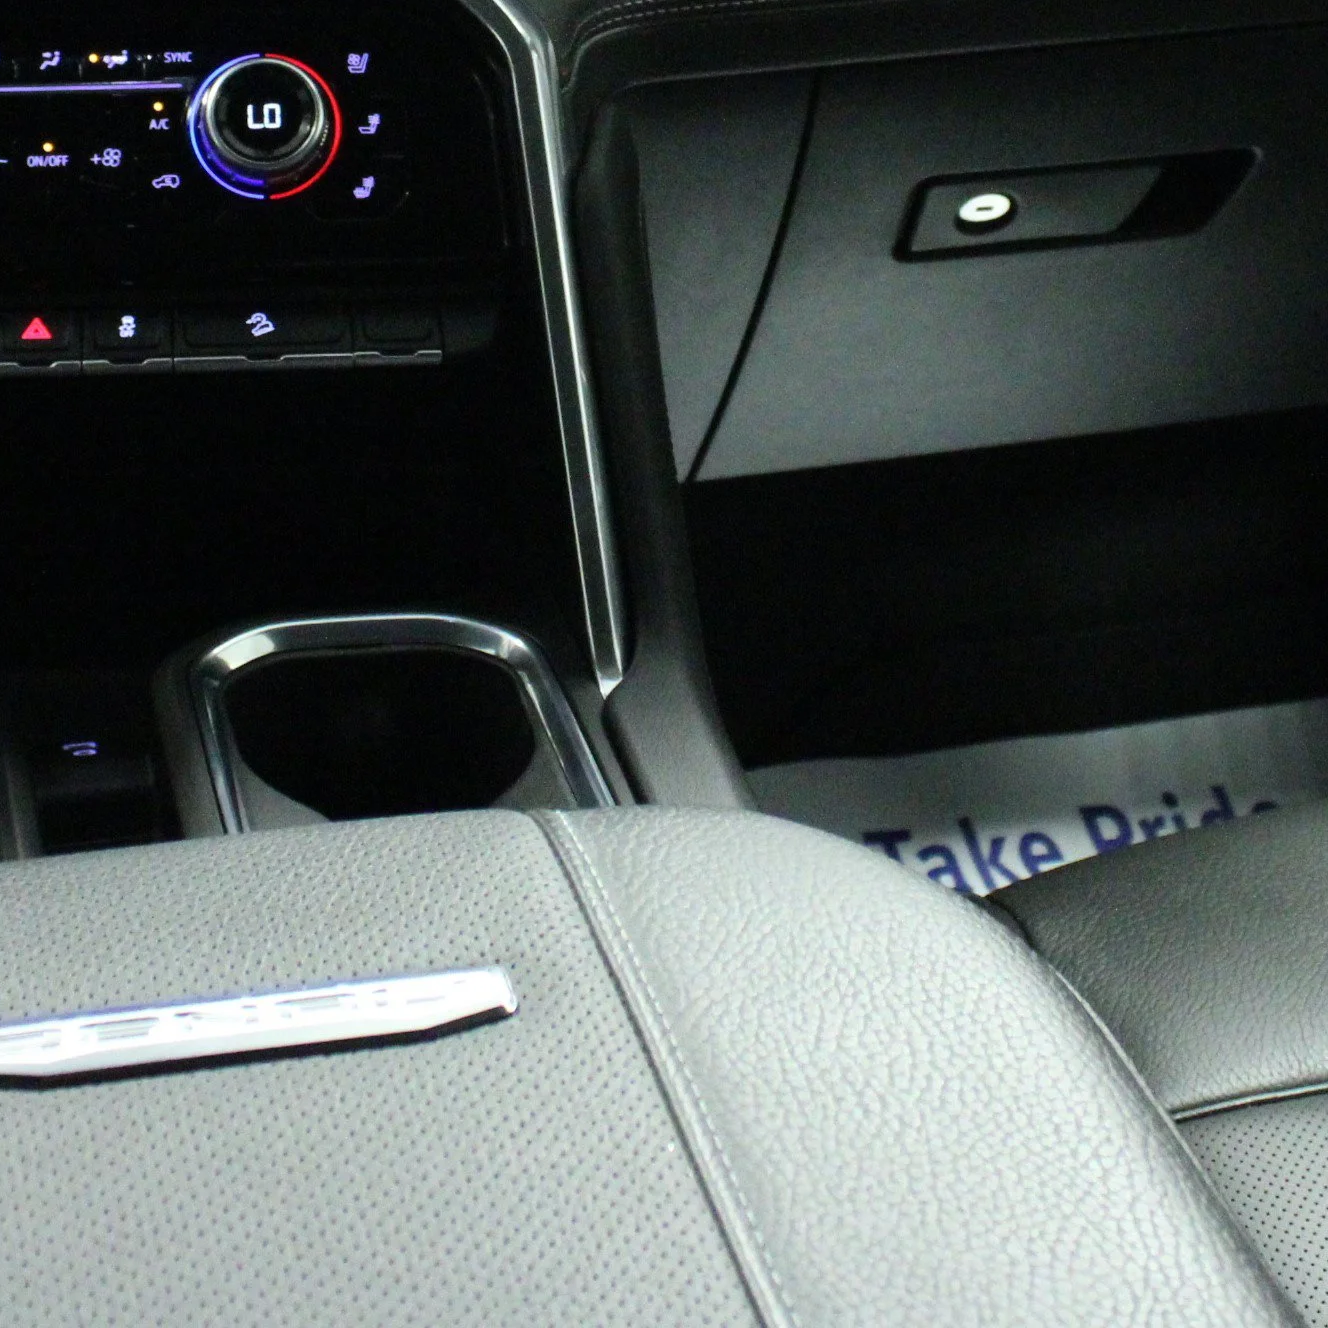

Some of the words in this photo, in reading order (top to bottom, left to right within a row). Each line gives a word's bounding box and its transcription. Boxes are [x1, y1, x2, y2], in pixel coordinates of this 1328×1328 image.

[163, 51, 193, 64] SYNC
[246, 102, 282, 130] LO
[149, 118, 170, 130] A/C
[26, 154, 70, 168] ON/OFF
[1077, 783, 1279, 856] Prid
